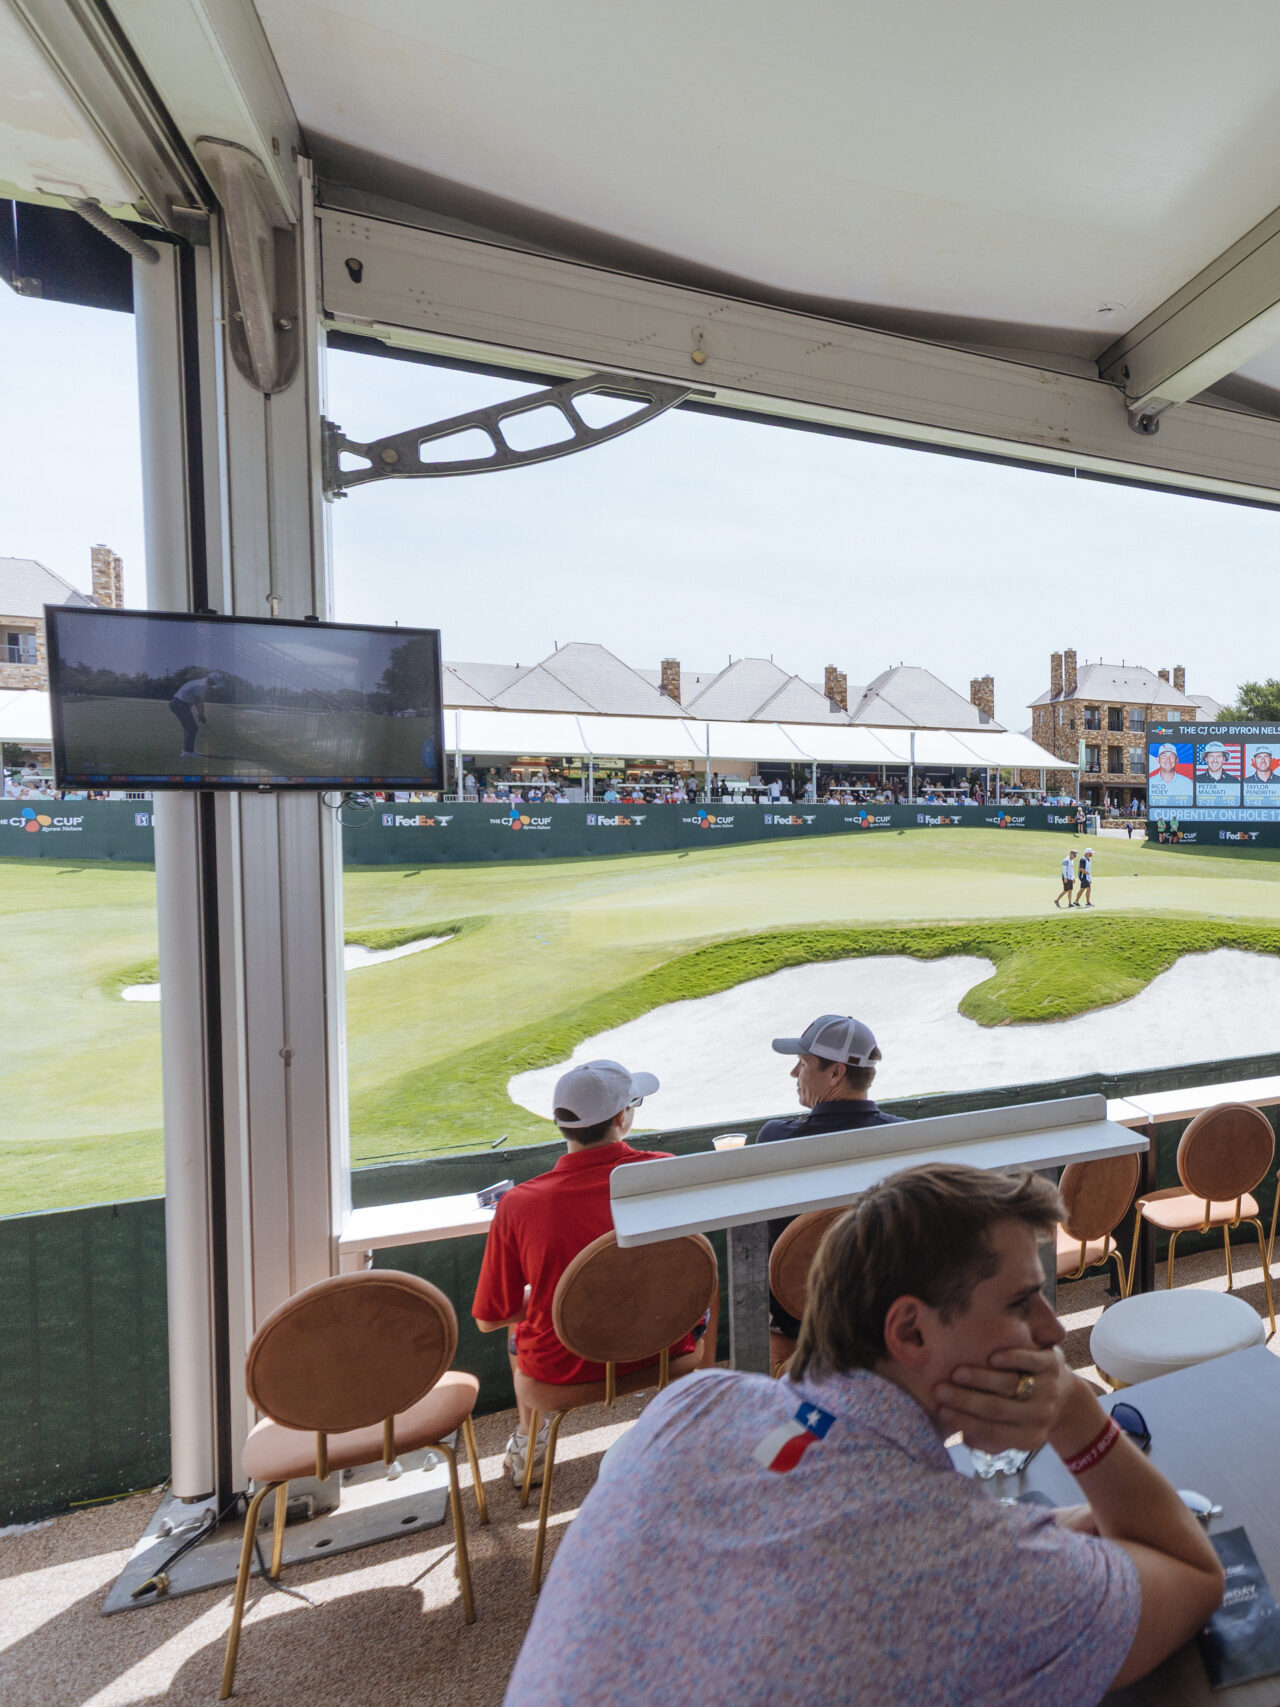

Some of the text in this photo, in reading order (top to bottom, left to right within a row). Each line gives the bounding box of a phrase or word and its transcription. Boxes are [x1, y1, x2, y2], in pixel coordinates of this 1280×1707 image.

[1179, 726, 1196, 734] THE
[1197, 726, 1208, 736] CJ
[1209, 726, 1228, 736] CUP
[1229, 727, 1260, 736] BYRON
[395, 815, 436, 826] FedEx
[597, 815, 632, 826] FedEx
[774, 815, 804, 825] FedEx
[925, 815, 951, 825] FedEx
[1054, 816, 1077, 824] FedEx
[1219, 811, 1234, 820] ON
[1238, 811, 1270, 820] HOLE
[9, 817, 27, 827] CJ
[53, 817, 82, 826] CUP
[501, 817, 514, 826] CJ
[1226, 832, 1249, 840] FedEx
